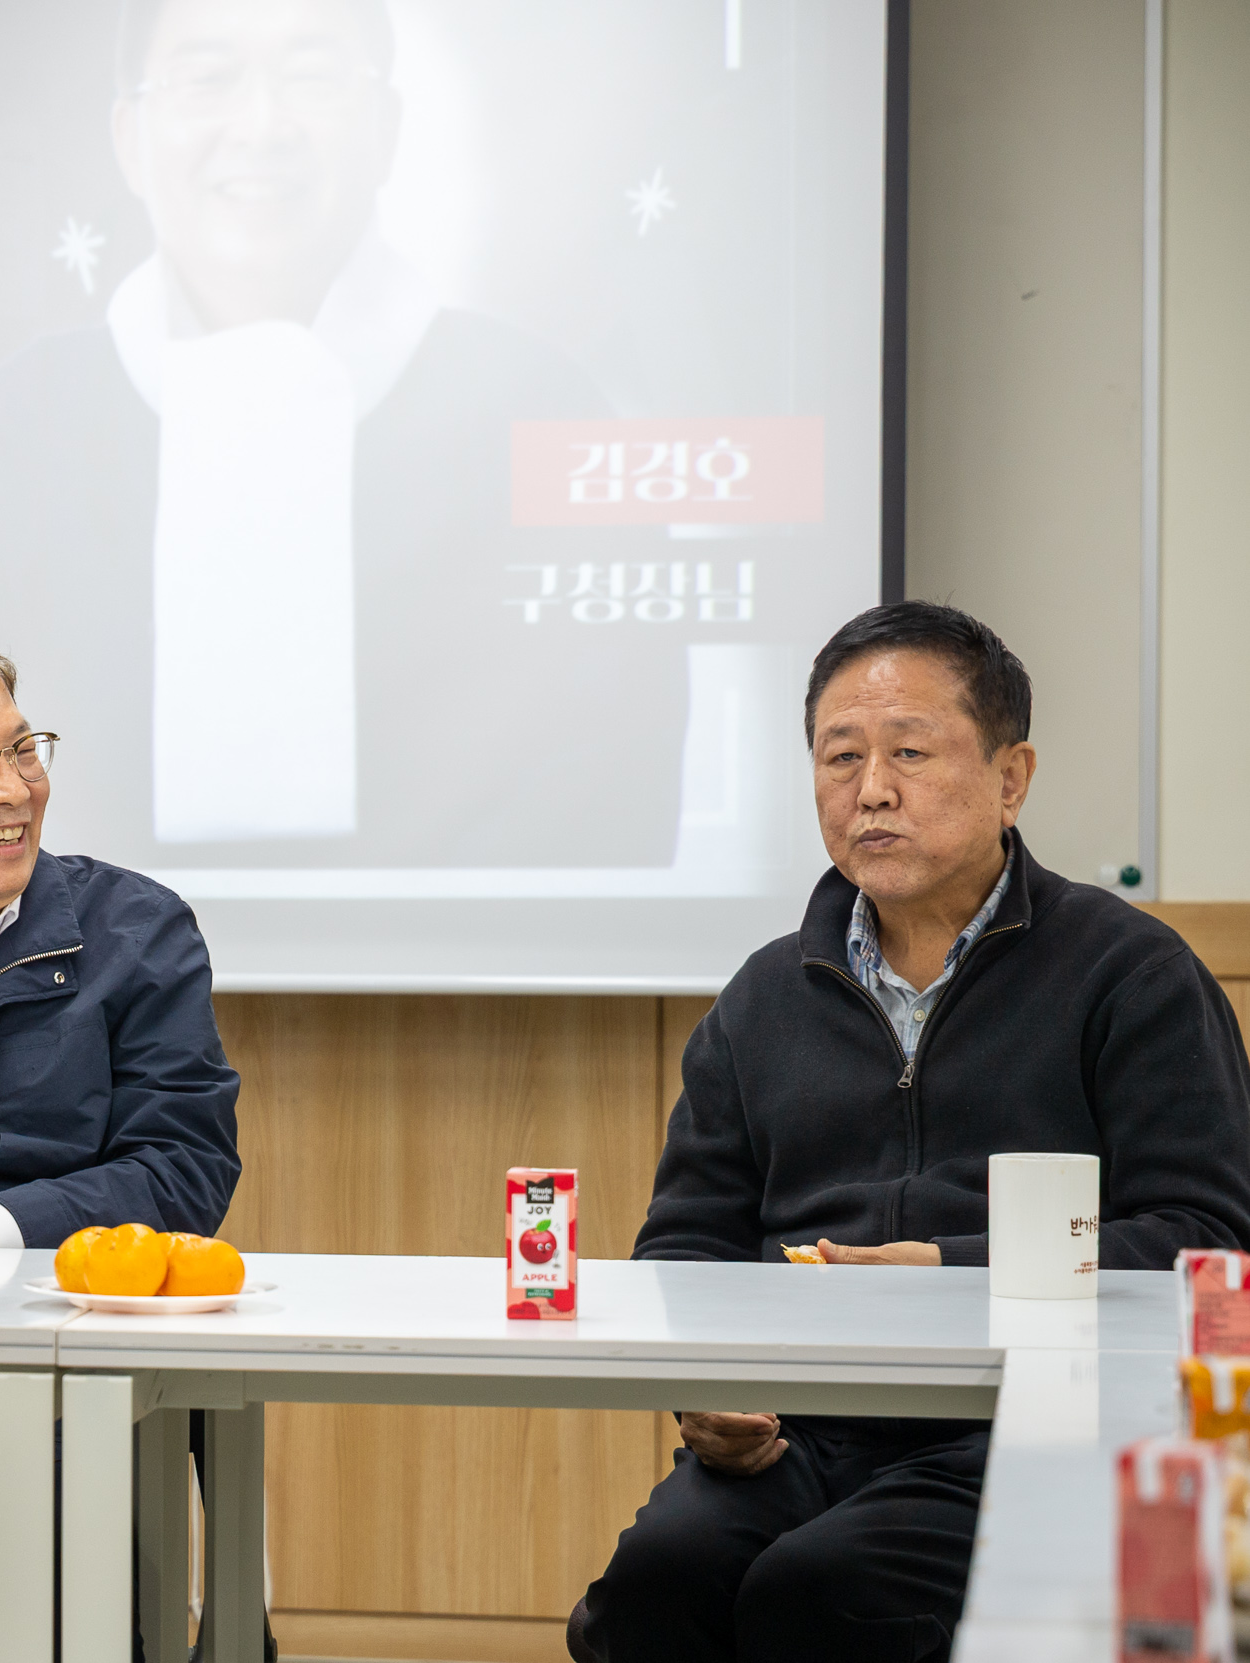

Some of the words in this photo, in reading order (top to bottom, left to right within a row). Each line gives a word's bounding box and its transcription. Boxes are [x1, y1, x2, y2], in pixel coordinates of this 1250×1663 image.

[567, 436, 754, 504] 김경호
[501, 560, 756, 625] 구청장님
[527, 1206, 552, 1215] JOY
[522, 1273, 558, 1282] APPLE
